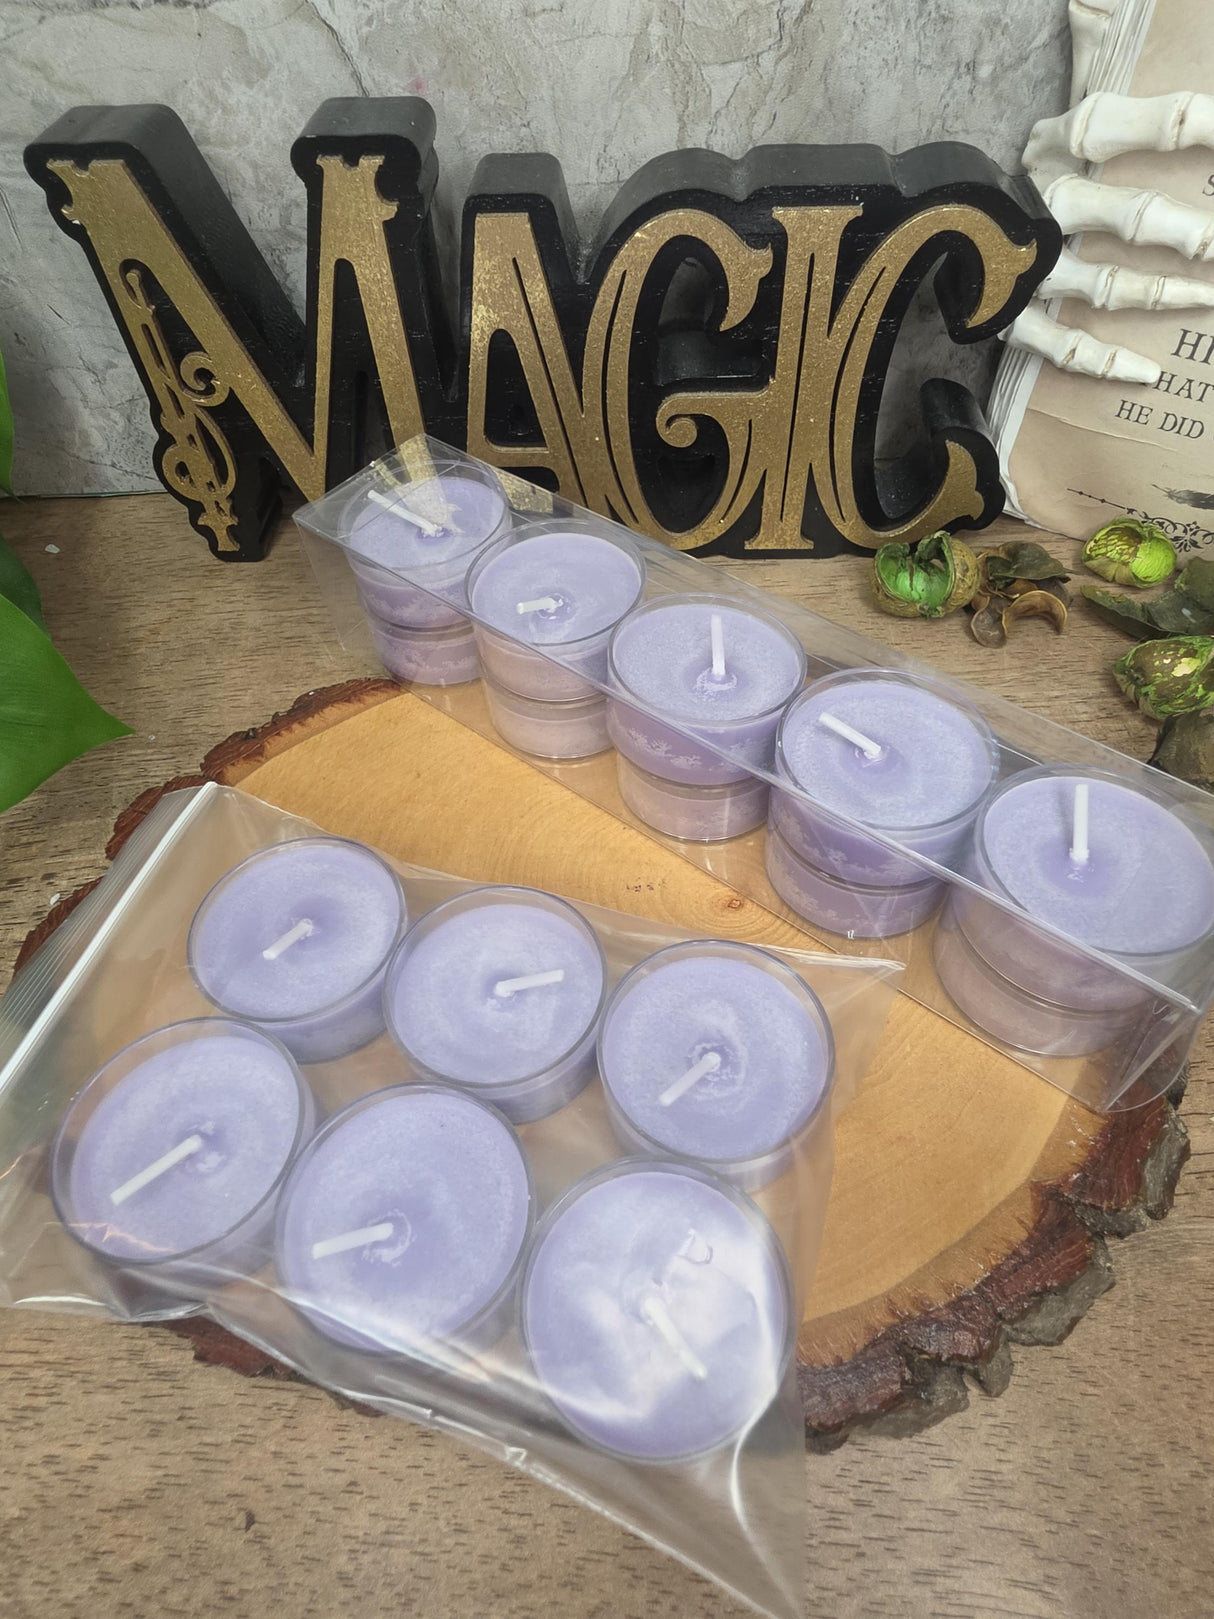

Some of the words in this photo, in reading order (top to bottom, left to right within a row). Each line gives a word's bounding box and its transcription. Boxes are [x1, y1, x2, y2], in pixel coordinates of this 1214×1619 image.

[45, 152, 1039, 554] MAGIC
[1139, 370, 1214, 403] HAT
[1115, 399, 1153, 426] HE
[1158, 411, 1205, 439] DID
